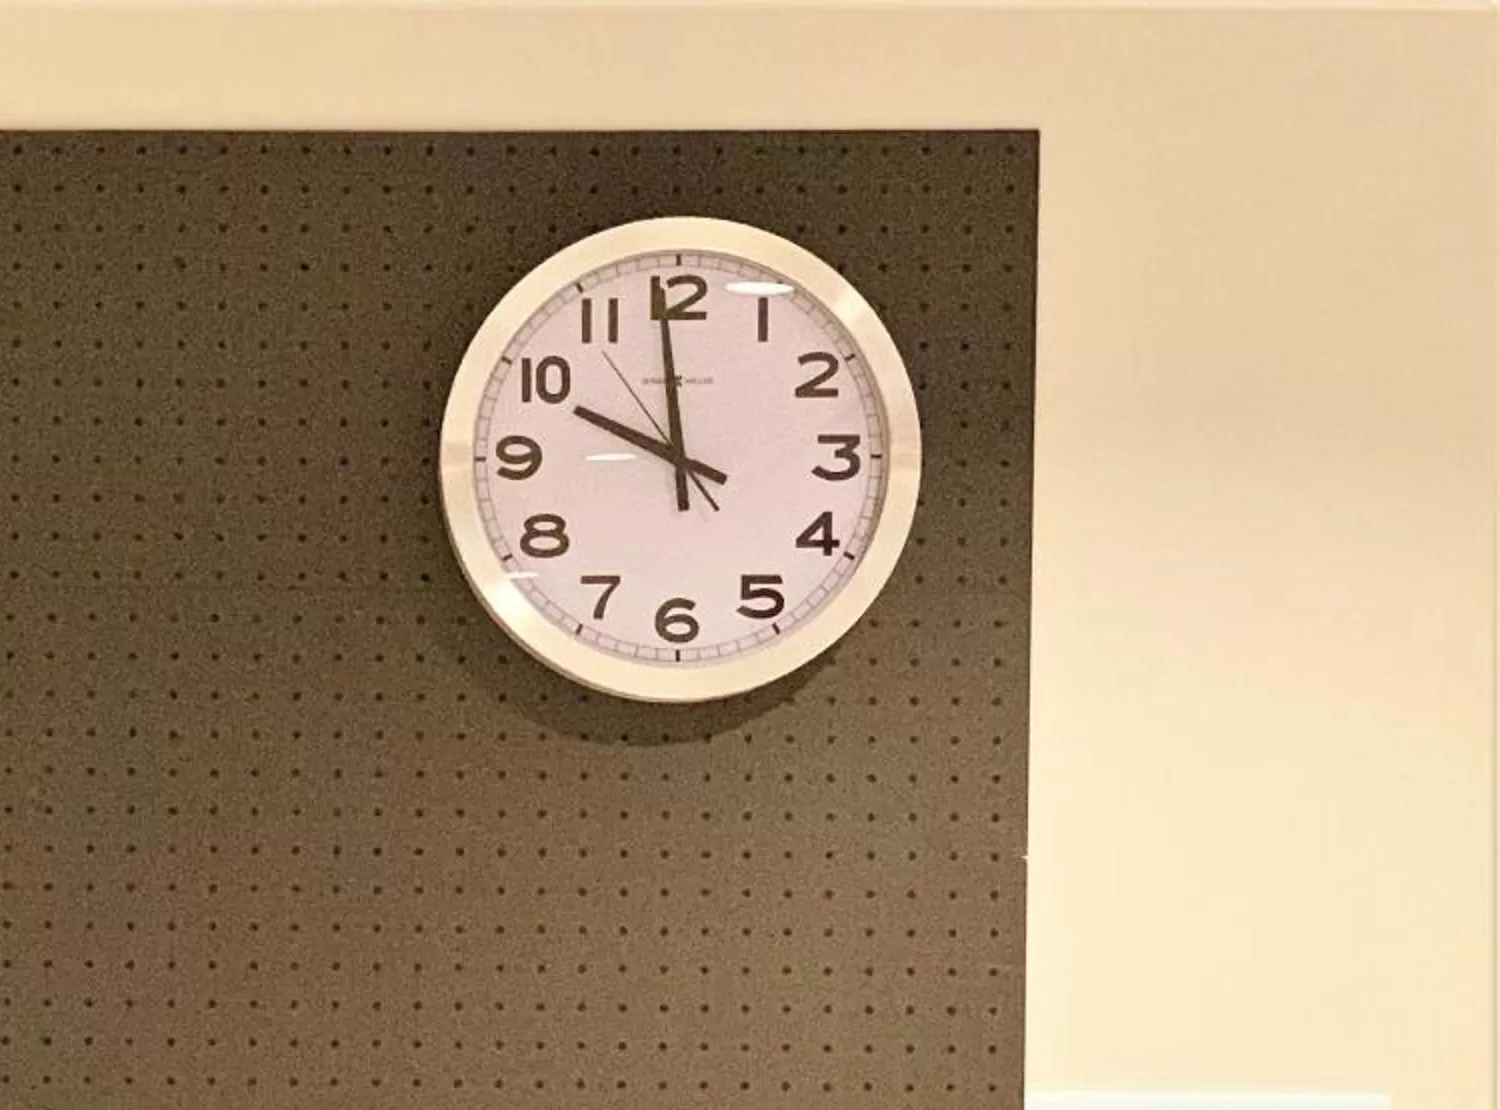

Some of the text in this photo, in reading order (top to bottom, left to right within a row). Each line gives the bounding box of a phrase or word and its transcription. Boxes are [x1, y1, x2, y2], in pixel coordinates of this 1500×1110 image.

[650, 275, 708, 320] 12
[756, 297, 769, 342] 1
[581, 298, 618, 343] 11
[521, 356, 571, 403] 10
[794, 352, 839, 398] 2
[495, 435, 542, 480] 9
[811, 434, 861, 481] 3
[520, 514, 570, 558] 8
[795, 511, 840, 556] 4
[580, 575, 621, 619] 7
[736, 574, 785, 619] 5
[654, 597, 700, 643] 6
